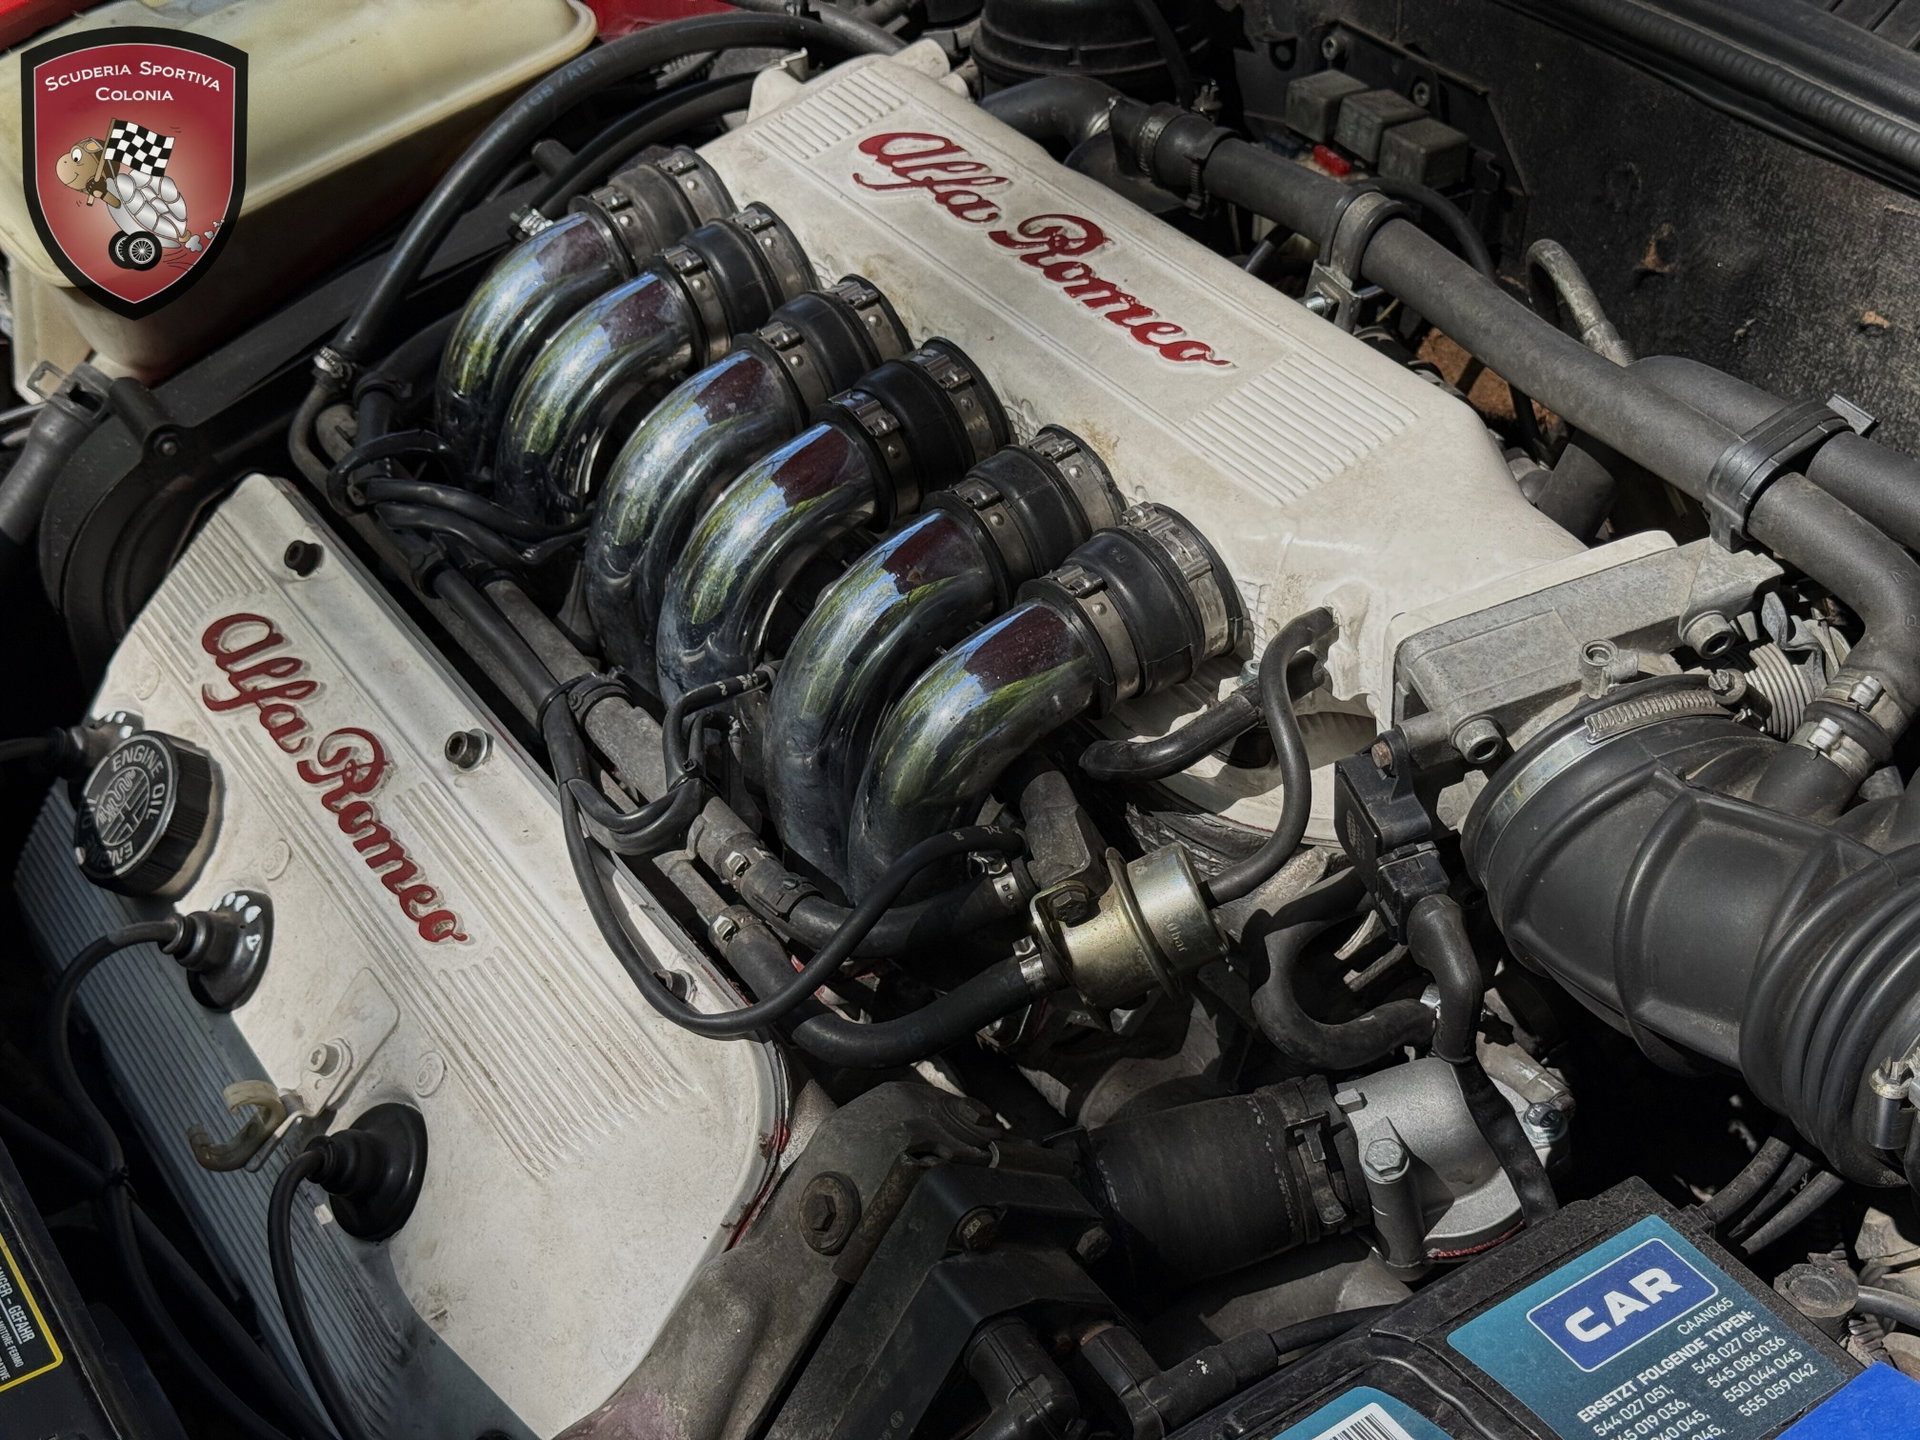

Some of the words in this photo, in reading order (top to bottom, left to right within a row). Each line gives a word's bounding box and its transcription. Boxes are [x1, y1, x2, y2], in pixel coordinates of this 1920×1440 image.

[852, 131, 1009, 224] Alfa
[988, 213, 1237, 367] Romeo
[111, 744, 165, 779] ENGINE
[146, 783, 166, 819] OIL
[202, 612, 319, 754] Alfa
[297, 727, 468, 943] Romeo
[8, 1304, 36, 1343] GEFAHR
[1564, 1268, 1683, 1342] CAR
[1677, 1297, 1734, 1336] CAAN065
[7, 1345, 24, 1368] FERMO
[1576, 1380, 1638, 1423] ERSETZT
[1636, 1338, 1709, 1386] FOLGENDE
[1704, 1309, 1755, 1341] TYPEN:
[1592, 1415, 1622, 1437] 544
[1619, 1398, 1645, 1420] 027
[1691, 1353, 1721, 1374] 548
[1717, 1337, 1743, 1358] 027
[1741, 1323, 1770, 1343] 054
[1634, 1415, 1659, 1435] 019
[1707, 1366, 1737, 1388] 545
[1733, 1351, 1761, 1371] 086
[1757, 1336, 1787, 1356] 036
[1722, 1381, 1752, 1402] 550
[1748, 1365, 1777, 1386] 044
[1773, 1348, 1803, 1369] 045
[1738, 1394, 1768, 1416] 555
[1764, 1379, 1791, 1399] 059
[1789, 1362, 1818, 1384] 042
